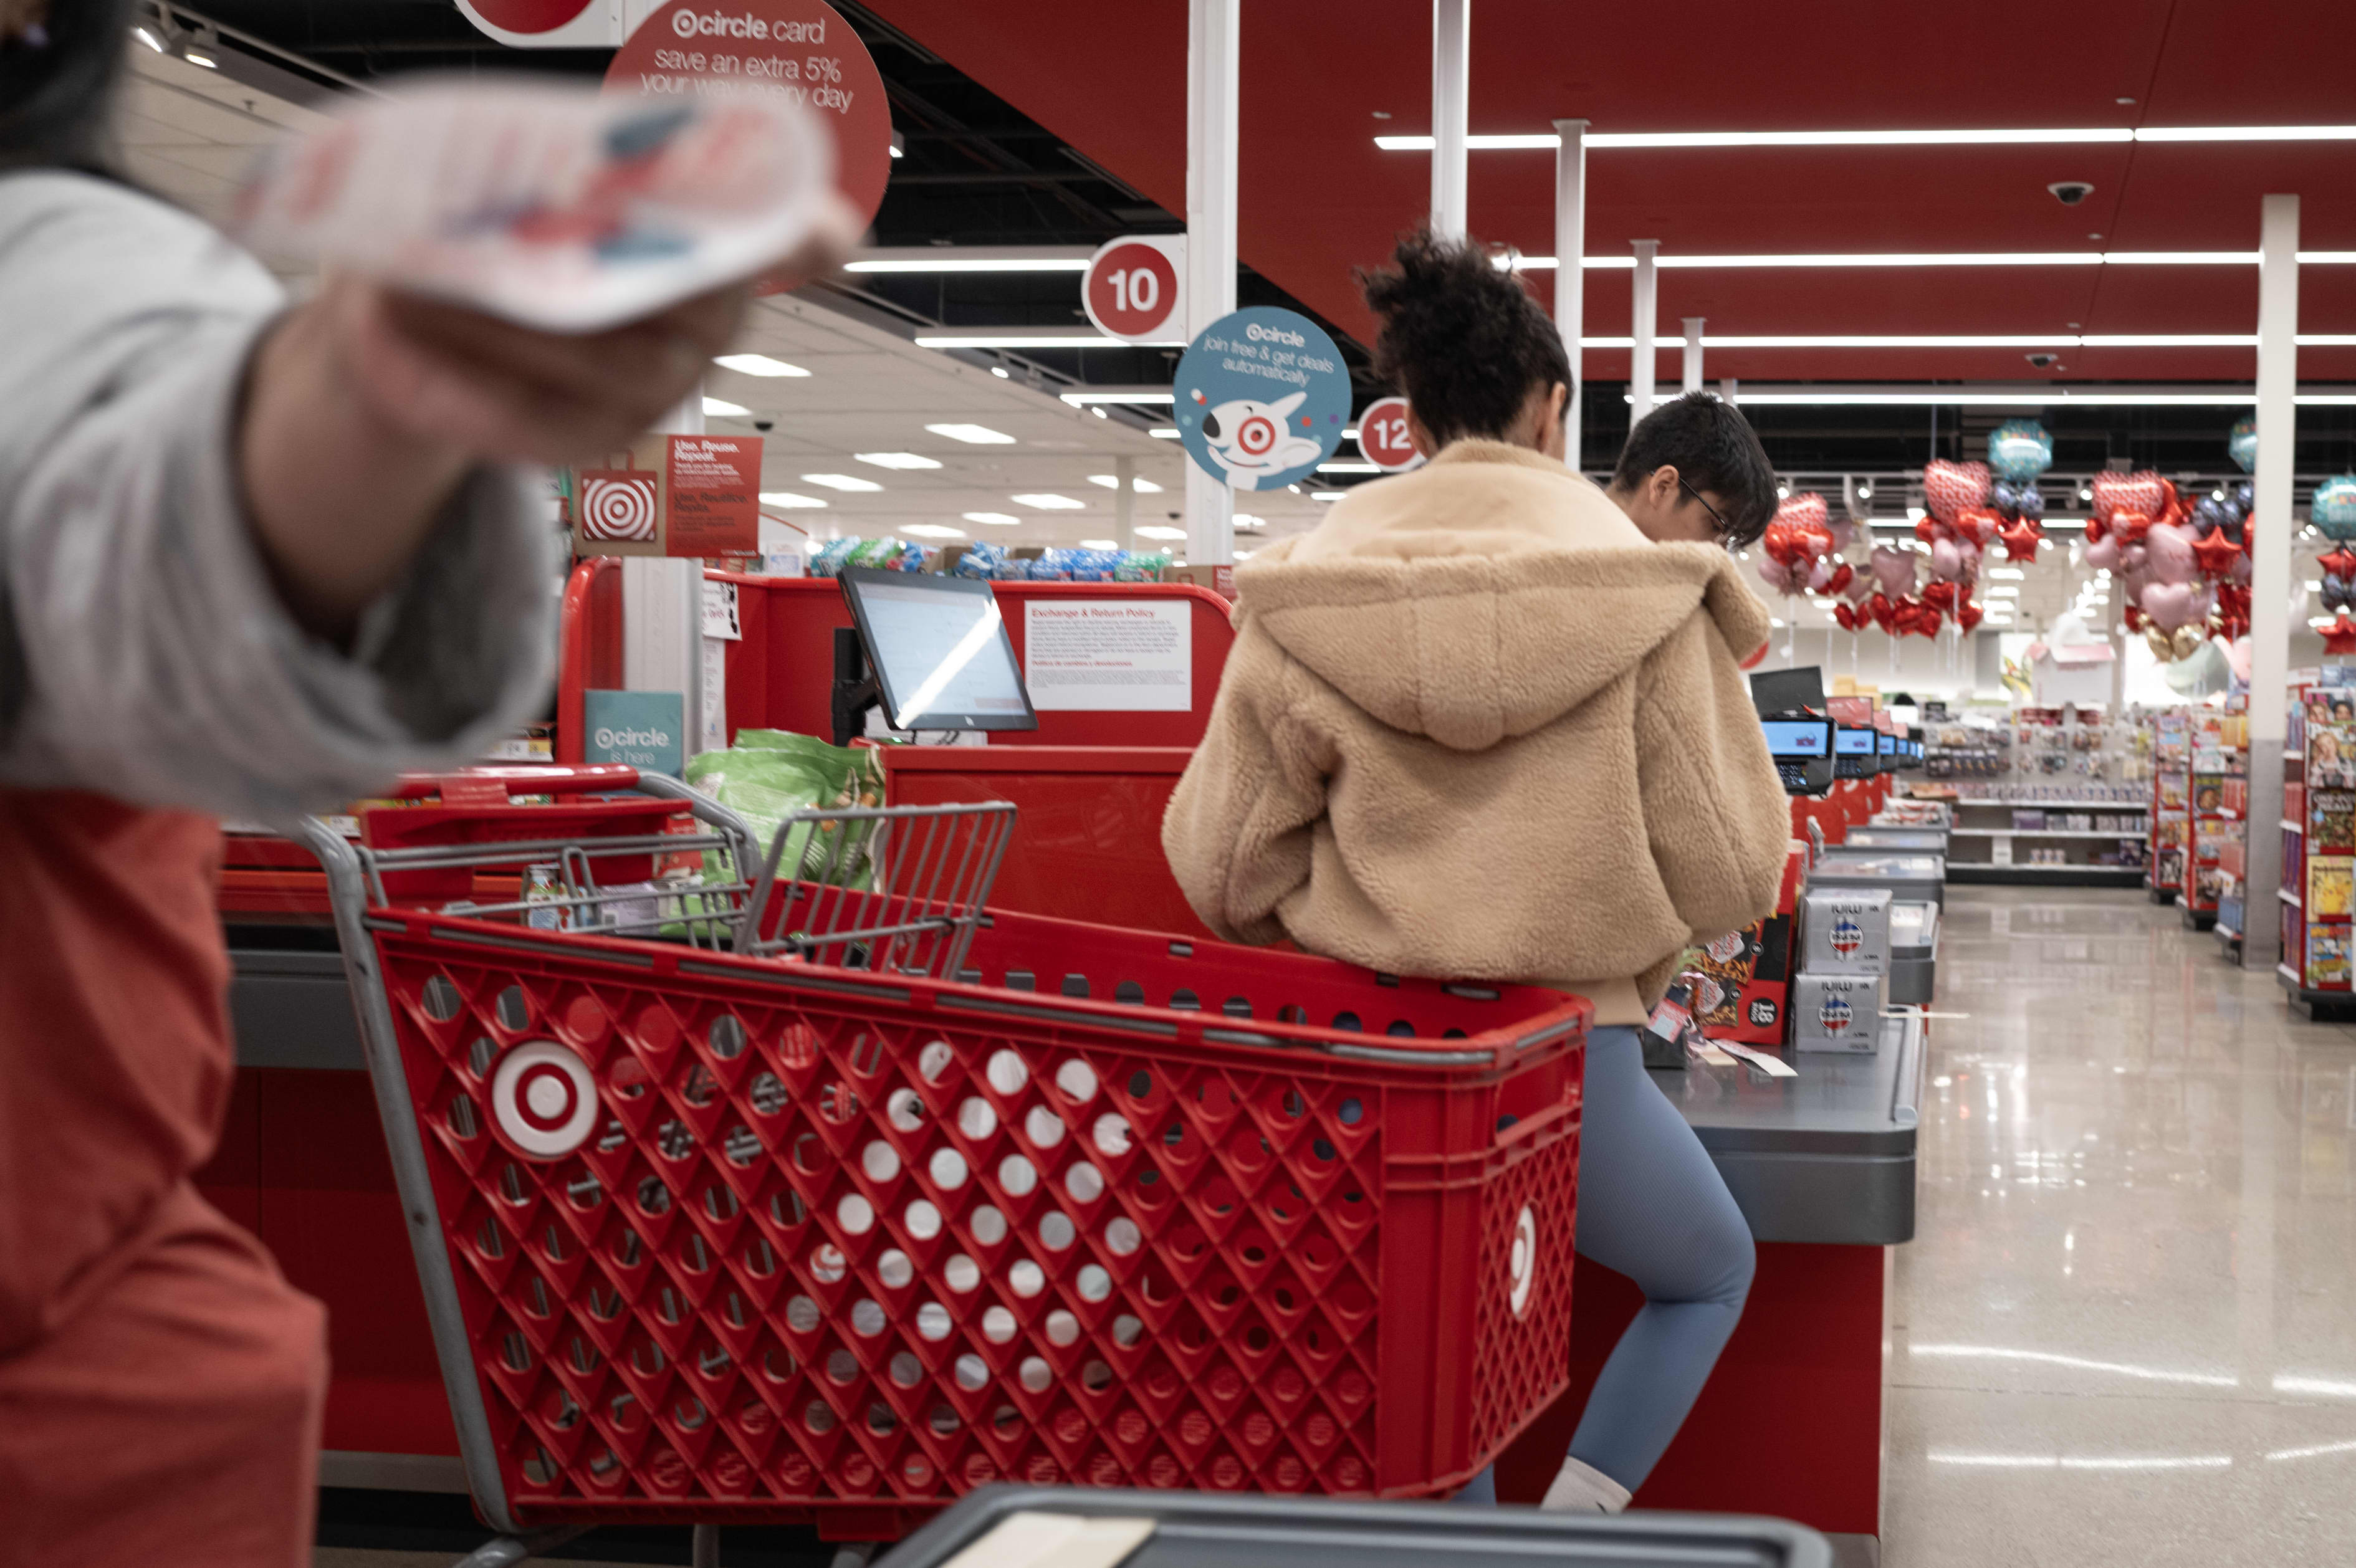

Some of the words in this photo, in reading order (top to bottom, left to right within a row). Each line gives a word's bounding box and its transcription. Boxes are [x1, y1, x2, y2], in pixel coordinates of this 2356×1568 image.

[697, 9, 769, 40] circle
[772, 17, 826, 44] card
[654, 49, 707, 72] save
[711, 54, 740, 75] an
[745, 54, 800, 80] extra
[805, 56, 842, 84] 5%
[639, 72, 689, 97] your
[812, 83, 854, 115] day
[1107, 267, 1159, 312] 10
[1261, 326, 1305, 348] circle
[1203, 334, 1228, 352] join
[1231, 340, 1258, 358] free
[1259, 345, 1270, 361] &
[1272, 350, 1296, 366] get
[1297, 354, 1334, 374] deals
[1222, 358, 1311, 388] automatically
[1373, 419, 1412, 449] 12
[1032, 608, 1079, 619] Exchange
[1081, 608, 1088, 617] &
[1091, 608, 1124, 617] Return
[1126, 608, 1156, 619] Policy
[615, 727, 669, 747] circle
[610, 748, 622, 763] is
[624, 748, 655, 765] here
[1758, 1003, 1775, 1023] 18
